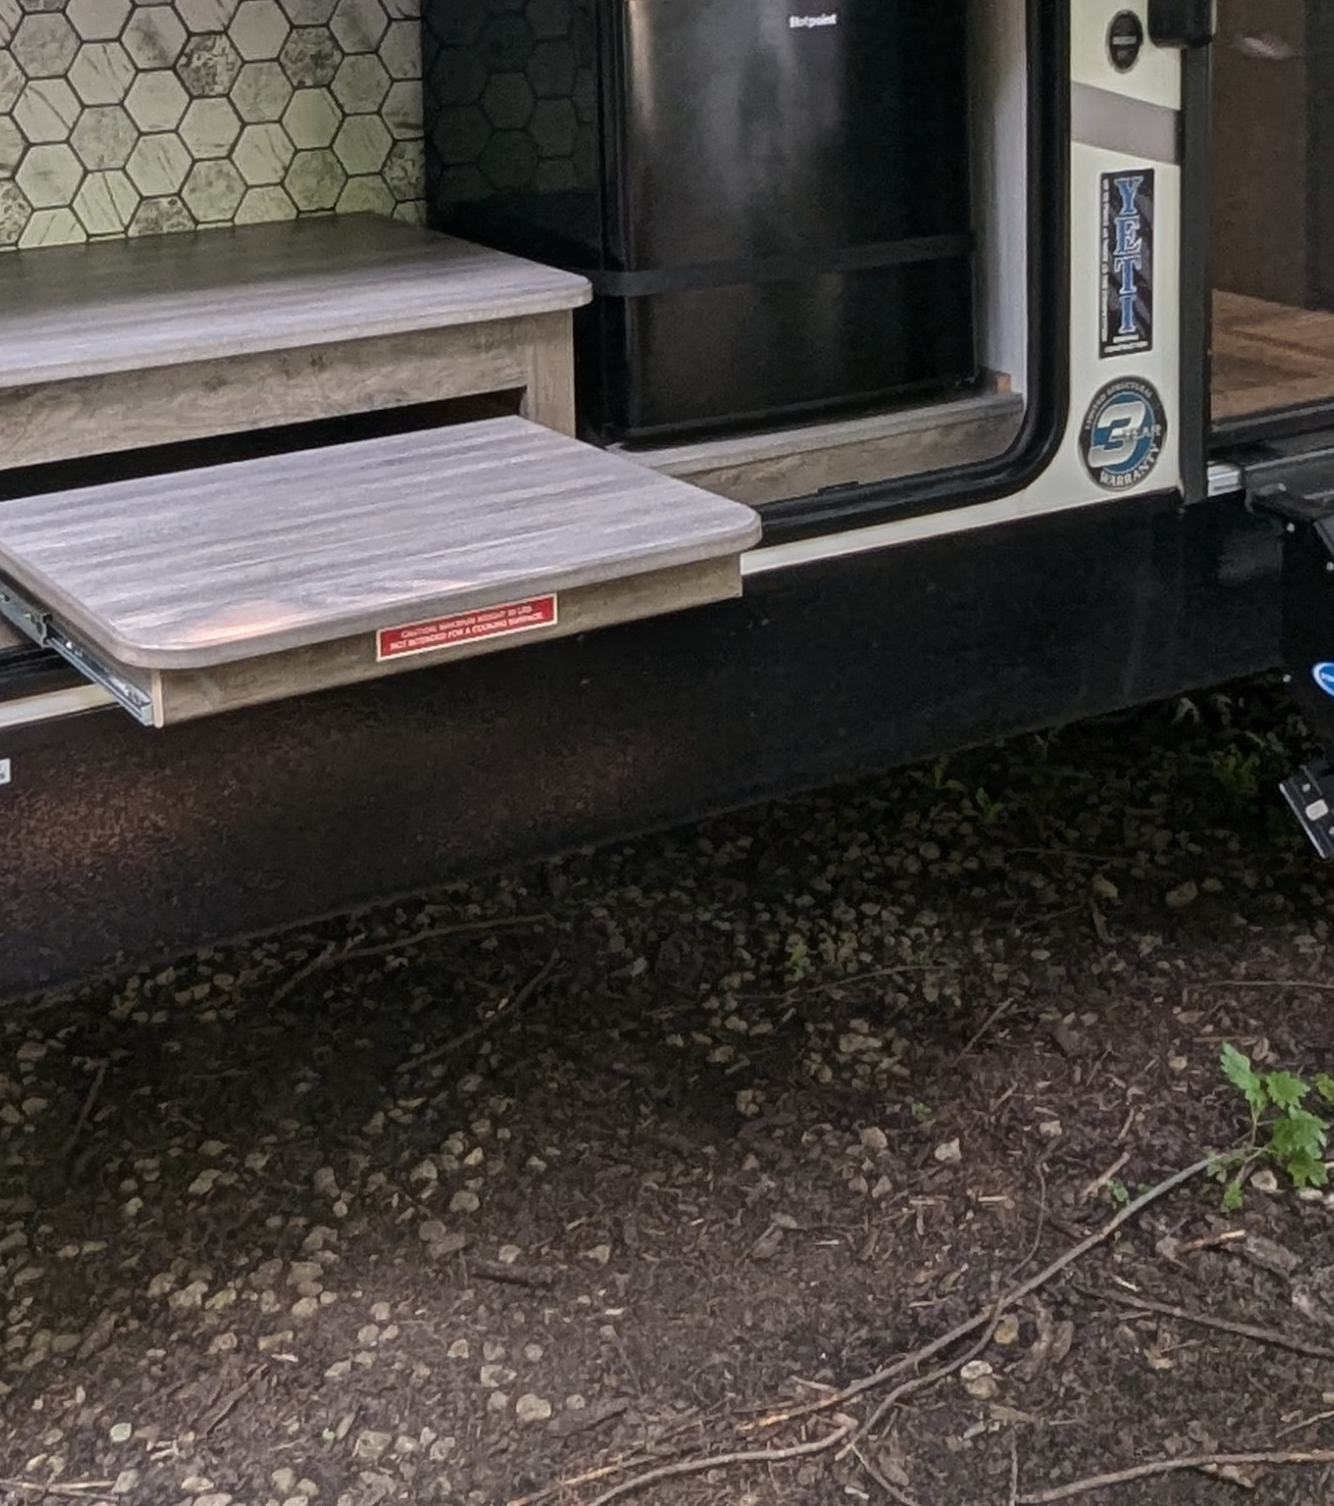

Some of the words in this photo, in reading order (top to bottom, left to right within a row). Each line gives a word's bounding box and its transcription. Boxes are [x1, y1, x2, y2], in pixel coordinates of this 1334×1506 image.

[789, 13, 836, 28] Hotpoint
[1113, 175, 1144, 334] YETI
[1088, 400, 1146, 468] 3
[1100, 444, 1160, 487] WARRANTY
[448, 629, 463, 639] FOR
